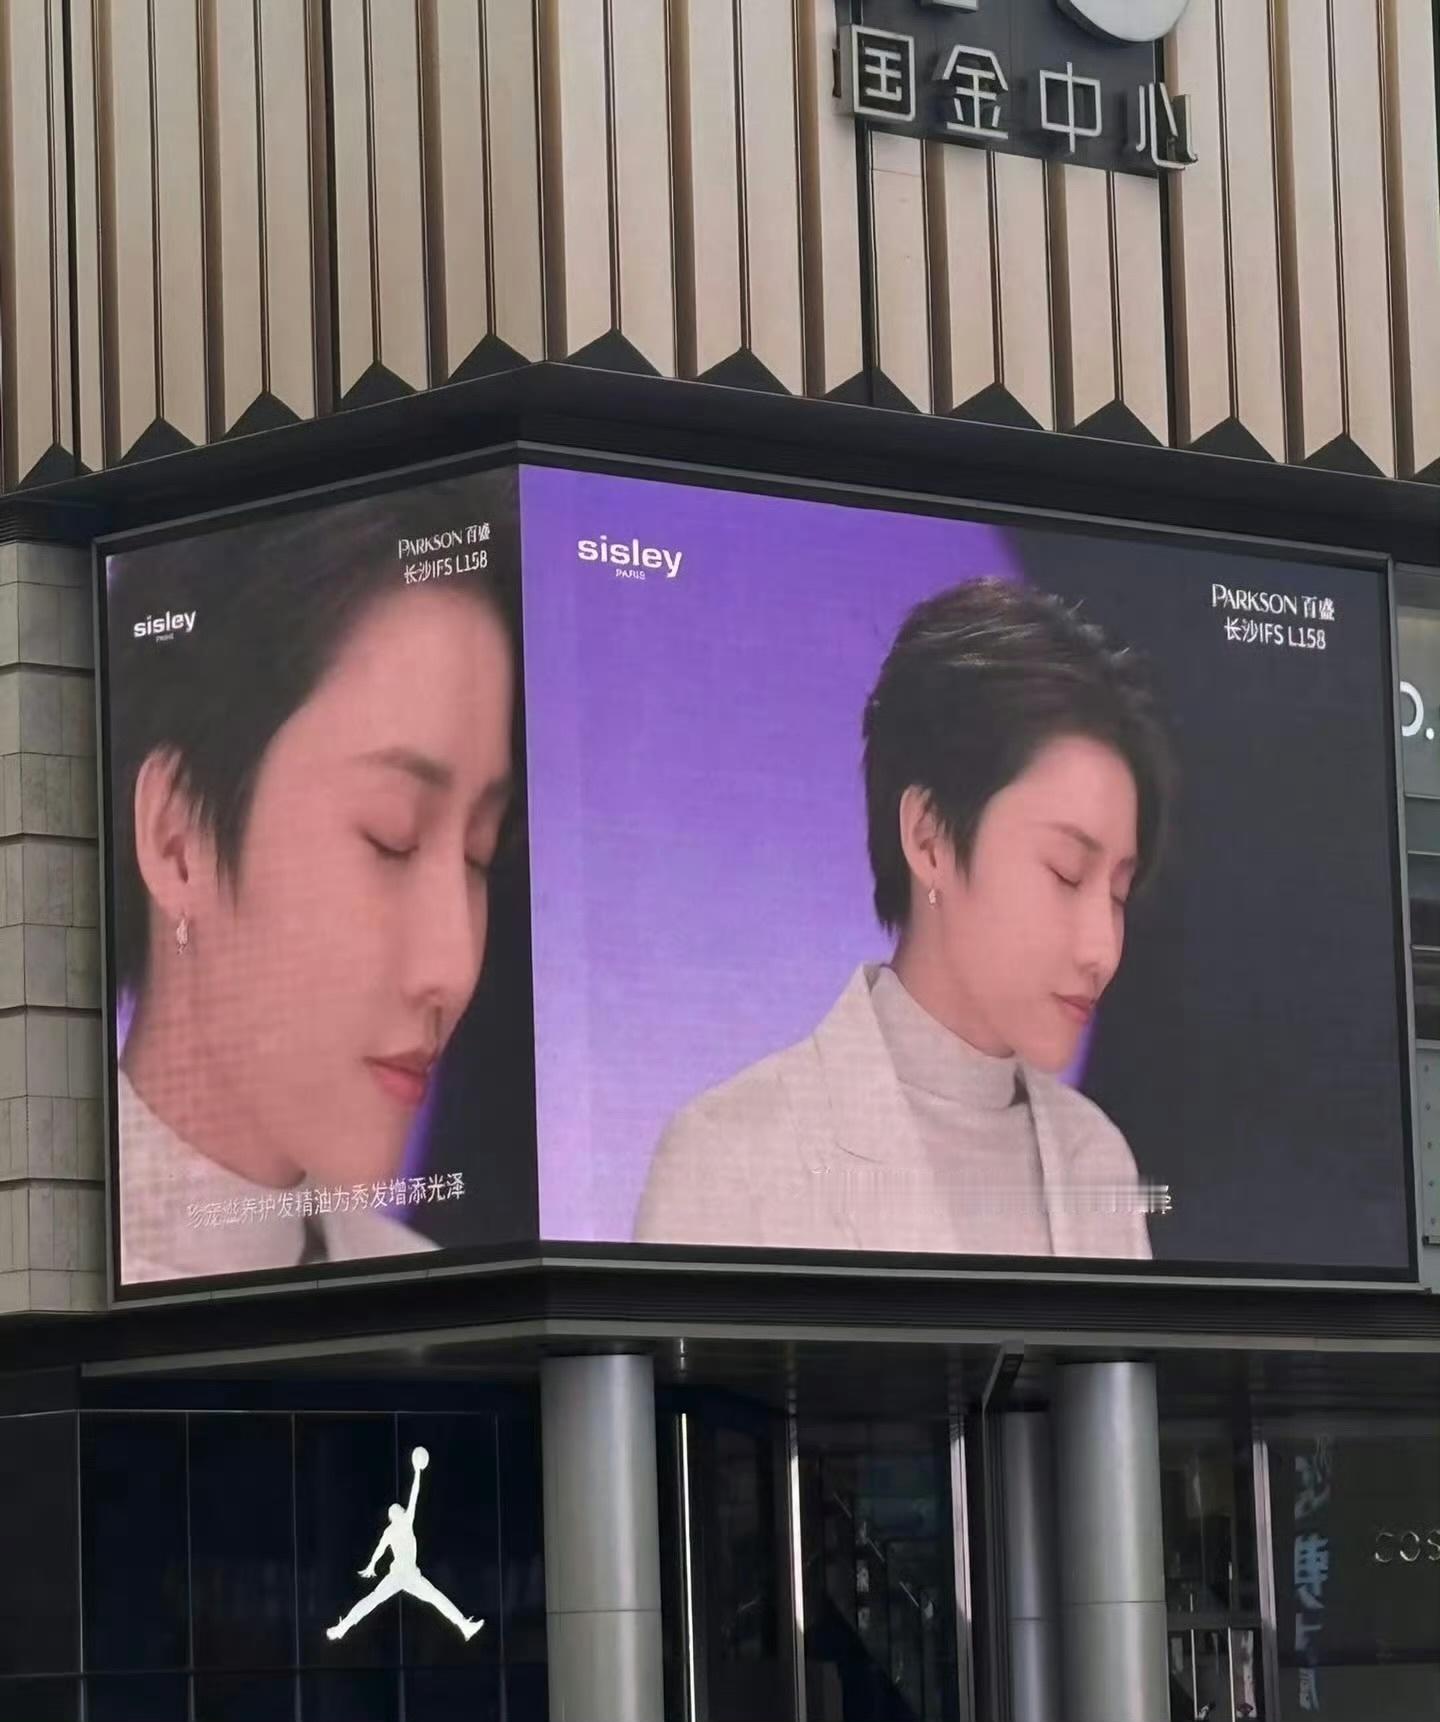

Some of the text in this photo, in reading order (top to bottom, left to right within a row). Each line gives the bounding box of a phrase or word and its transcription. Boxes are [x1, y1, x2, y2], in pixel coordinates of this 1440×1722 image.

[851, 24, 1199, 170] 国金中心
[399, 529, 463, 559] PARKSON
[578, 534, 683, 578] sisley
[404, 550, 488, 585] 长沙IFS L158
[1212, 583, 1298, 616] PARKSON
[133, 610, 197, 638] sisley
[1224, 616, 1327, 650] 长沙IFS L158
